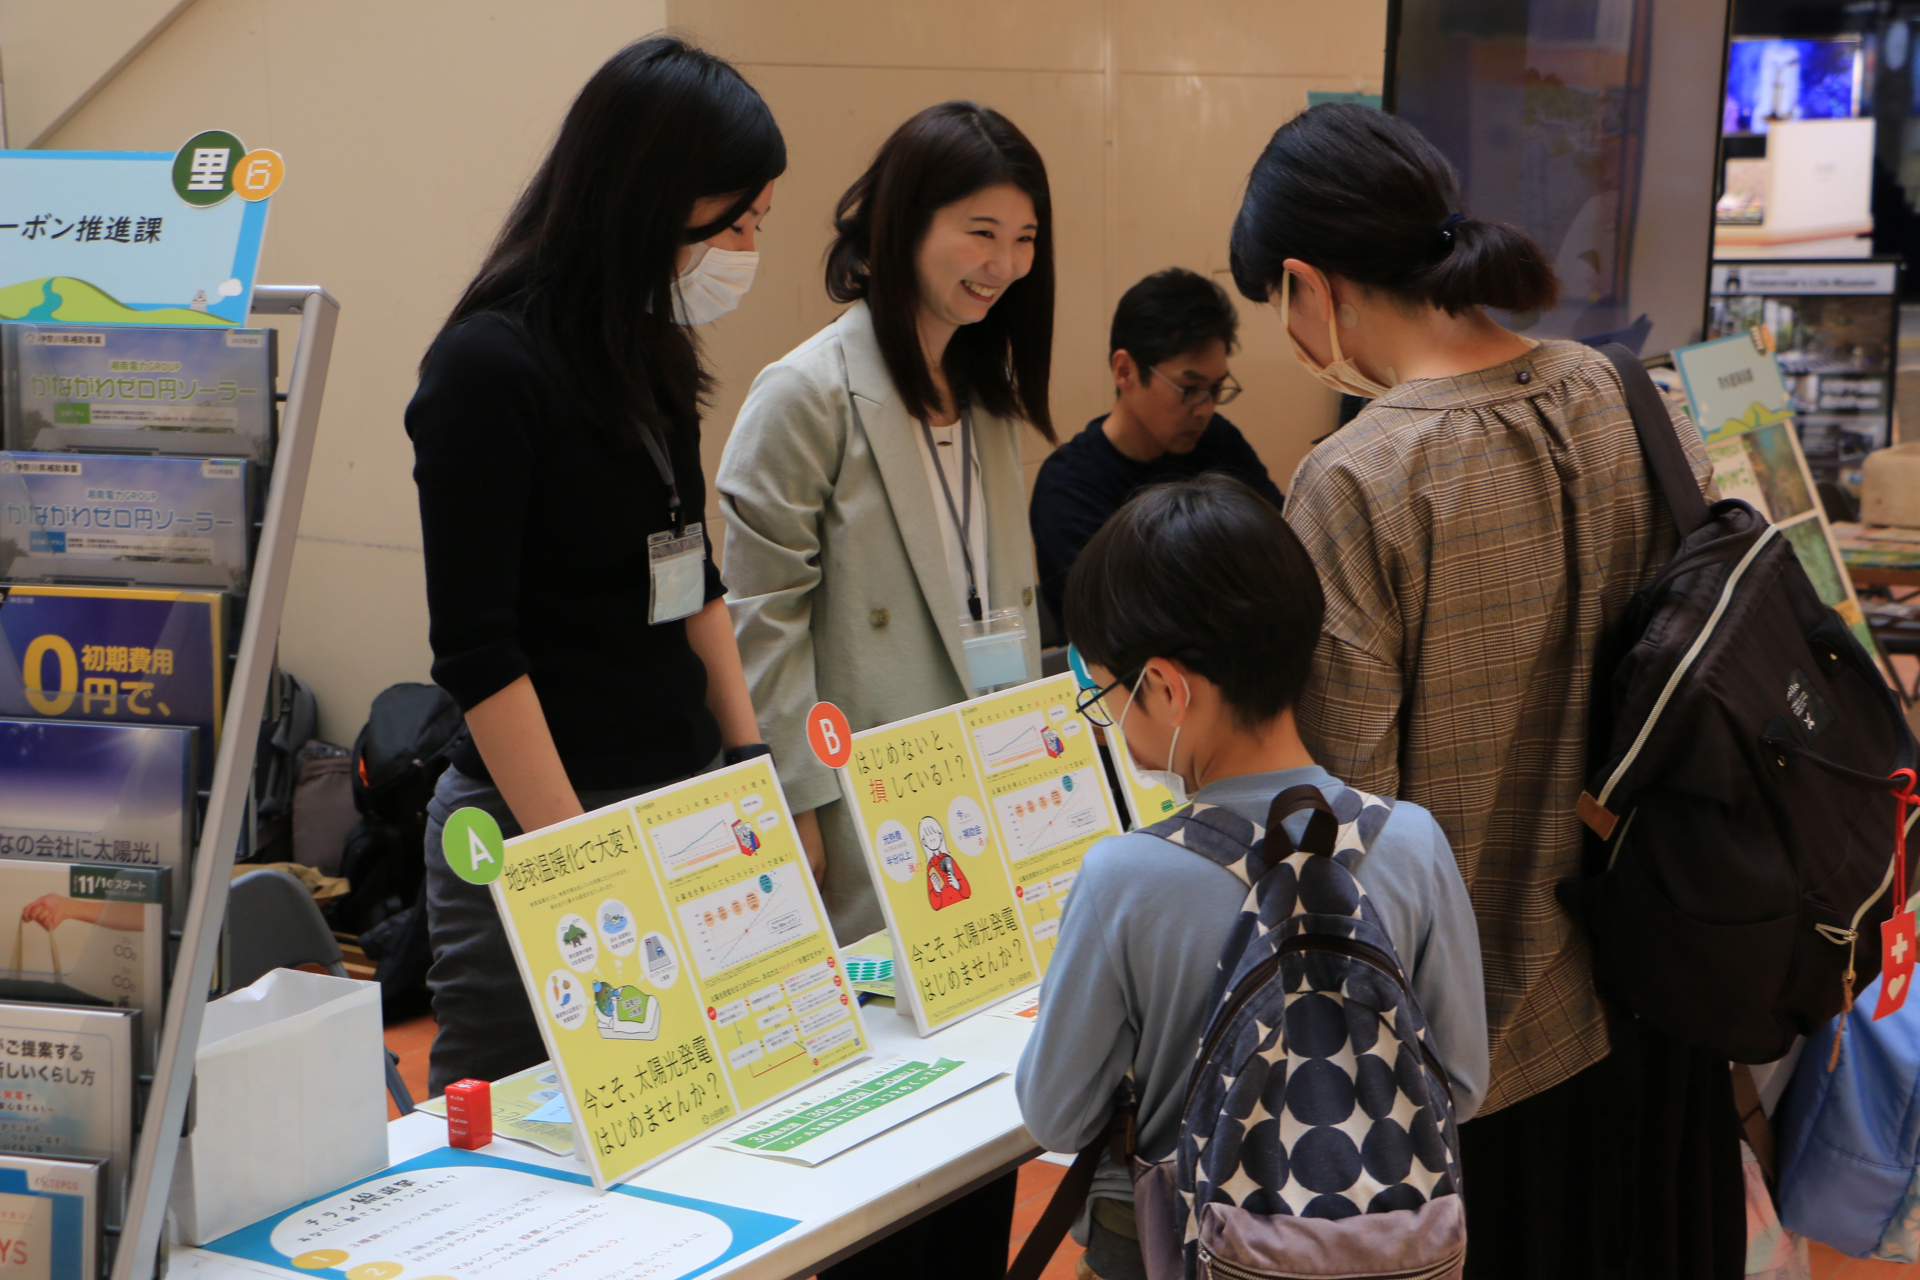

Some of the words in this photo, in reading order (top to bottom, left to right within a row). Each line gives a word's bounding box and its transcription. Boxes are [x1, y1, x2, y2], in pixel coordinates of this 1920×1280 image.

[187, 148, 230, 191] 里
[245, 159, 272, 190] 6
[0, 213, 163, 245] ーボン推進課
[110, 359, 182, 373] 湘南電力GROUP
[30, 375, 257, 401] かながわゼロ円ソーラー
[86, 489, 158, 501] 湘南電力GROUP
[7, 504, 233, 531] かながわゼロ円ソーラー
[23, 634, 78, 716] 0
[81, 644, 173, 675] 初期費用
[83, 677, 171, 716] 円で、
[819, 717, 841, 755] B
[855, 730, 953, 774] はじめないと、
[869, 755, 965, 803] 損している！？
[468, 825, 496, 871] A
[503, 825, 637, 891] 地球温暖化で大変！
[913, 907, 1018, 966] 今こそ、太陽光発電
[920, 938, 1023, 1002] はじめませんか？
[585, 1035, 713, 1109] 今こそ、太陽光発電
[595, 1072, 720, 1156] はじめませんか？
[304, 1178, 417, 1226] チラシ総選挙
[364, 1267, 387, 1277] 2
